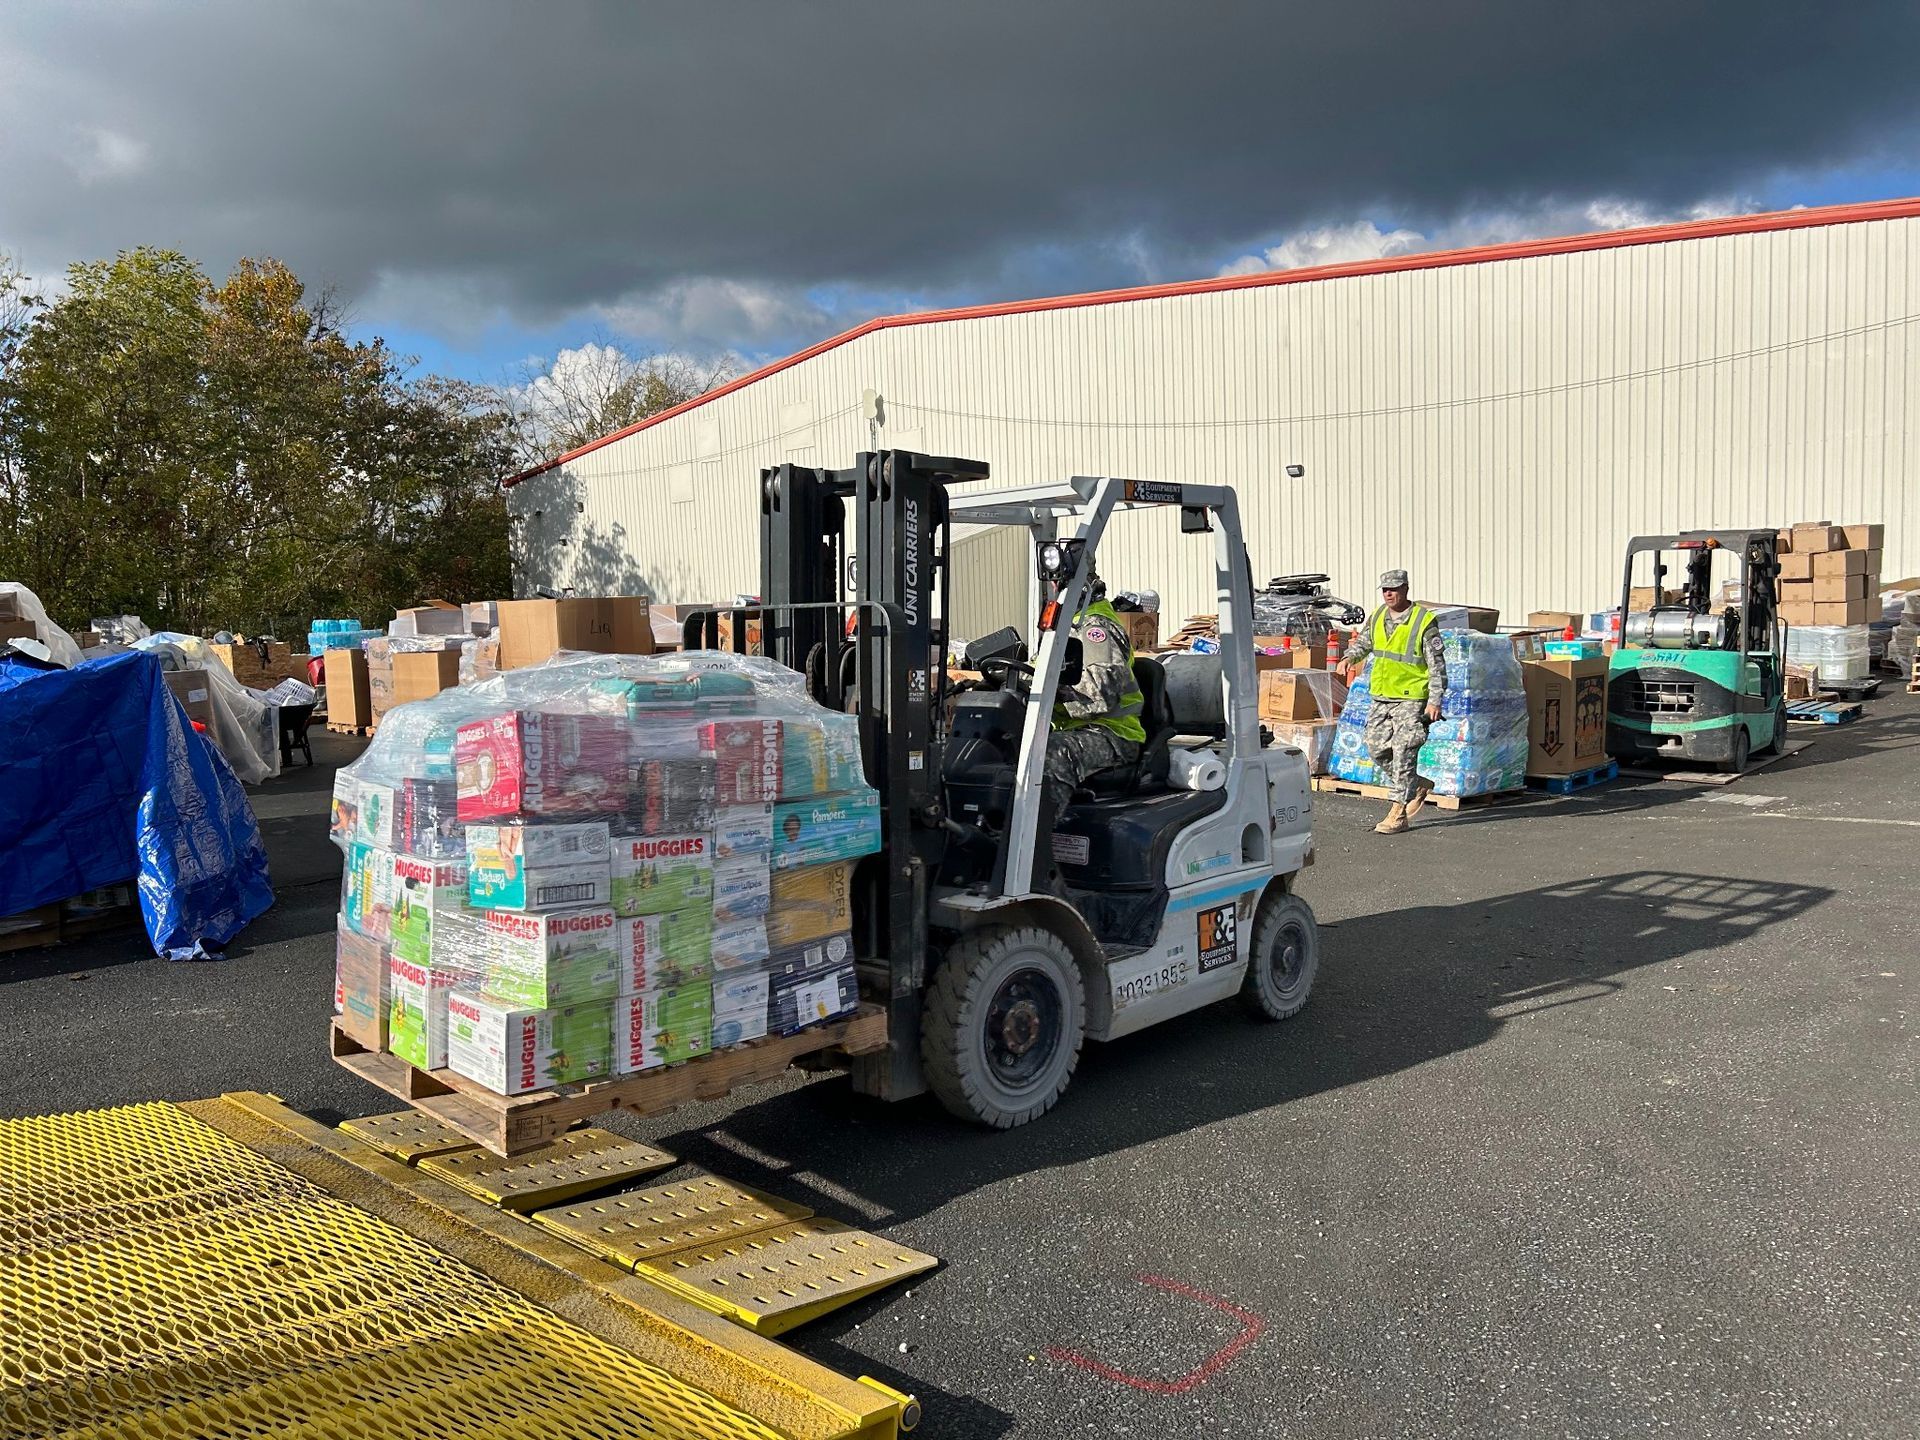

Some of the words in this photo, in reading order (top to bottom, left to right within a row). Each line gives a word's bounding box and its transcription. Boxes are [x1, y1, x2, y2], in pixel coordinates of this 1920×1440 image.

[905, 498, 918, 626] UNICARRIERS
[523, 709, 543, 811] HUGGIES
[763, 720, 777, 801] HUGGIES
[812, 809, 846, 824] Pampers
[1276, 805, 1297, 825] 50
[632, 837, 704, 860] HUGGIES
[394, 858, 432, 884] HUGGIES
[834, 866, 845, 919] DYPER
[547, 913, 613, 937] HUGGIES
[390, 956, 427, 987] HUGGIES
[632, 919, 646, 990] HUGGIES
[449, 996, 481, 1023] HUGGIES
[520, 1015, 537, 1089] HUGGIES
[630, 997, 643, 1067] HUGGIES
